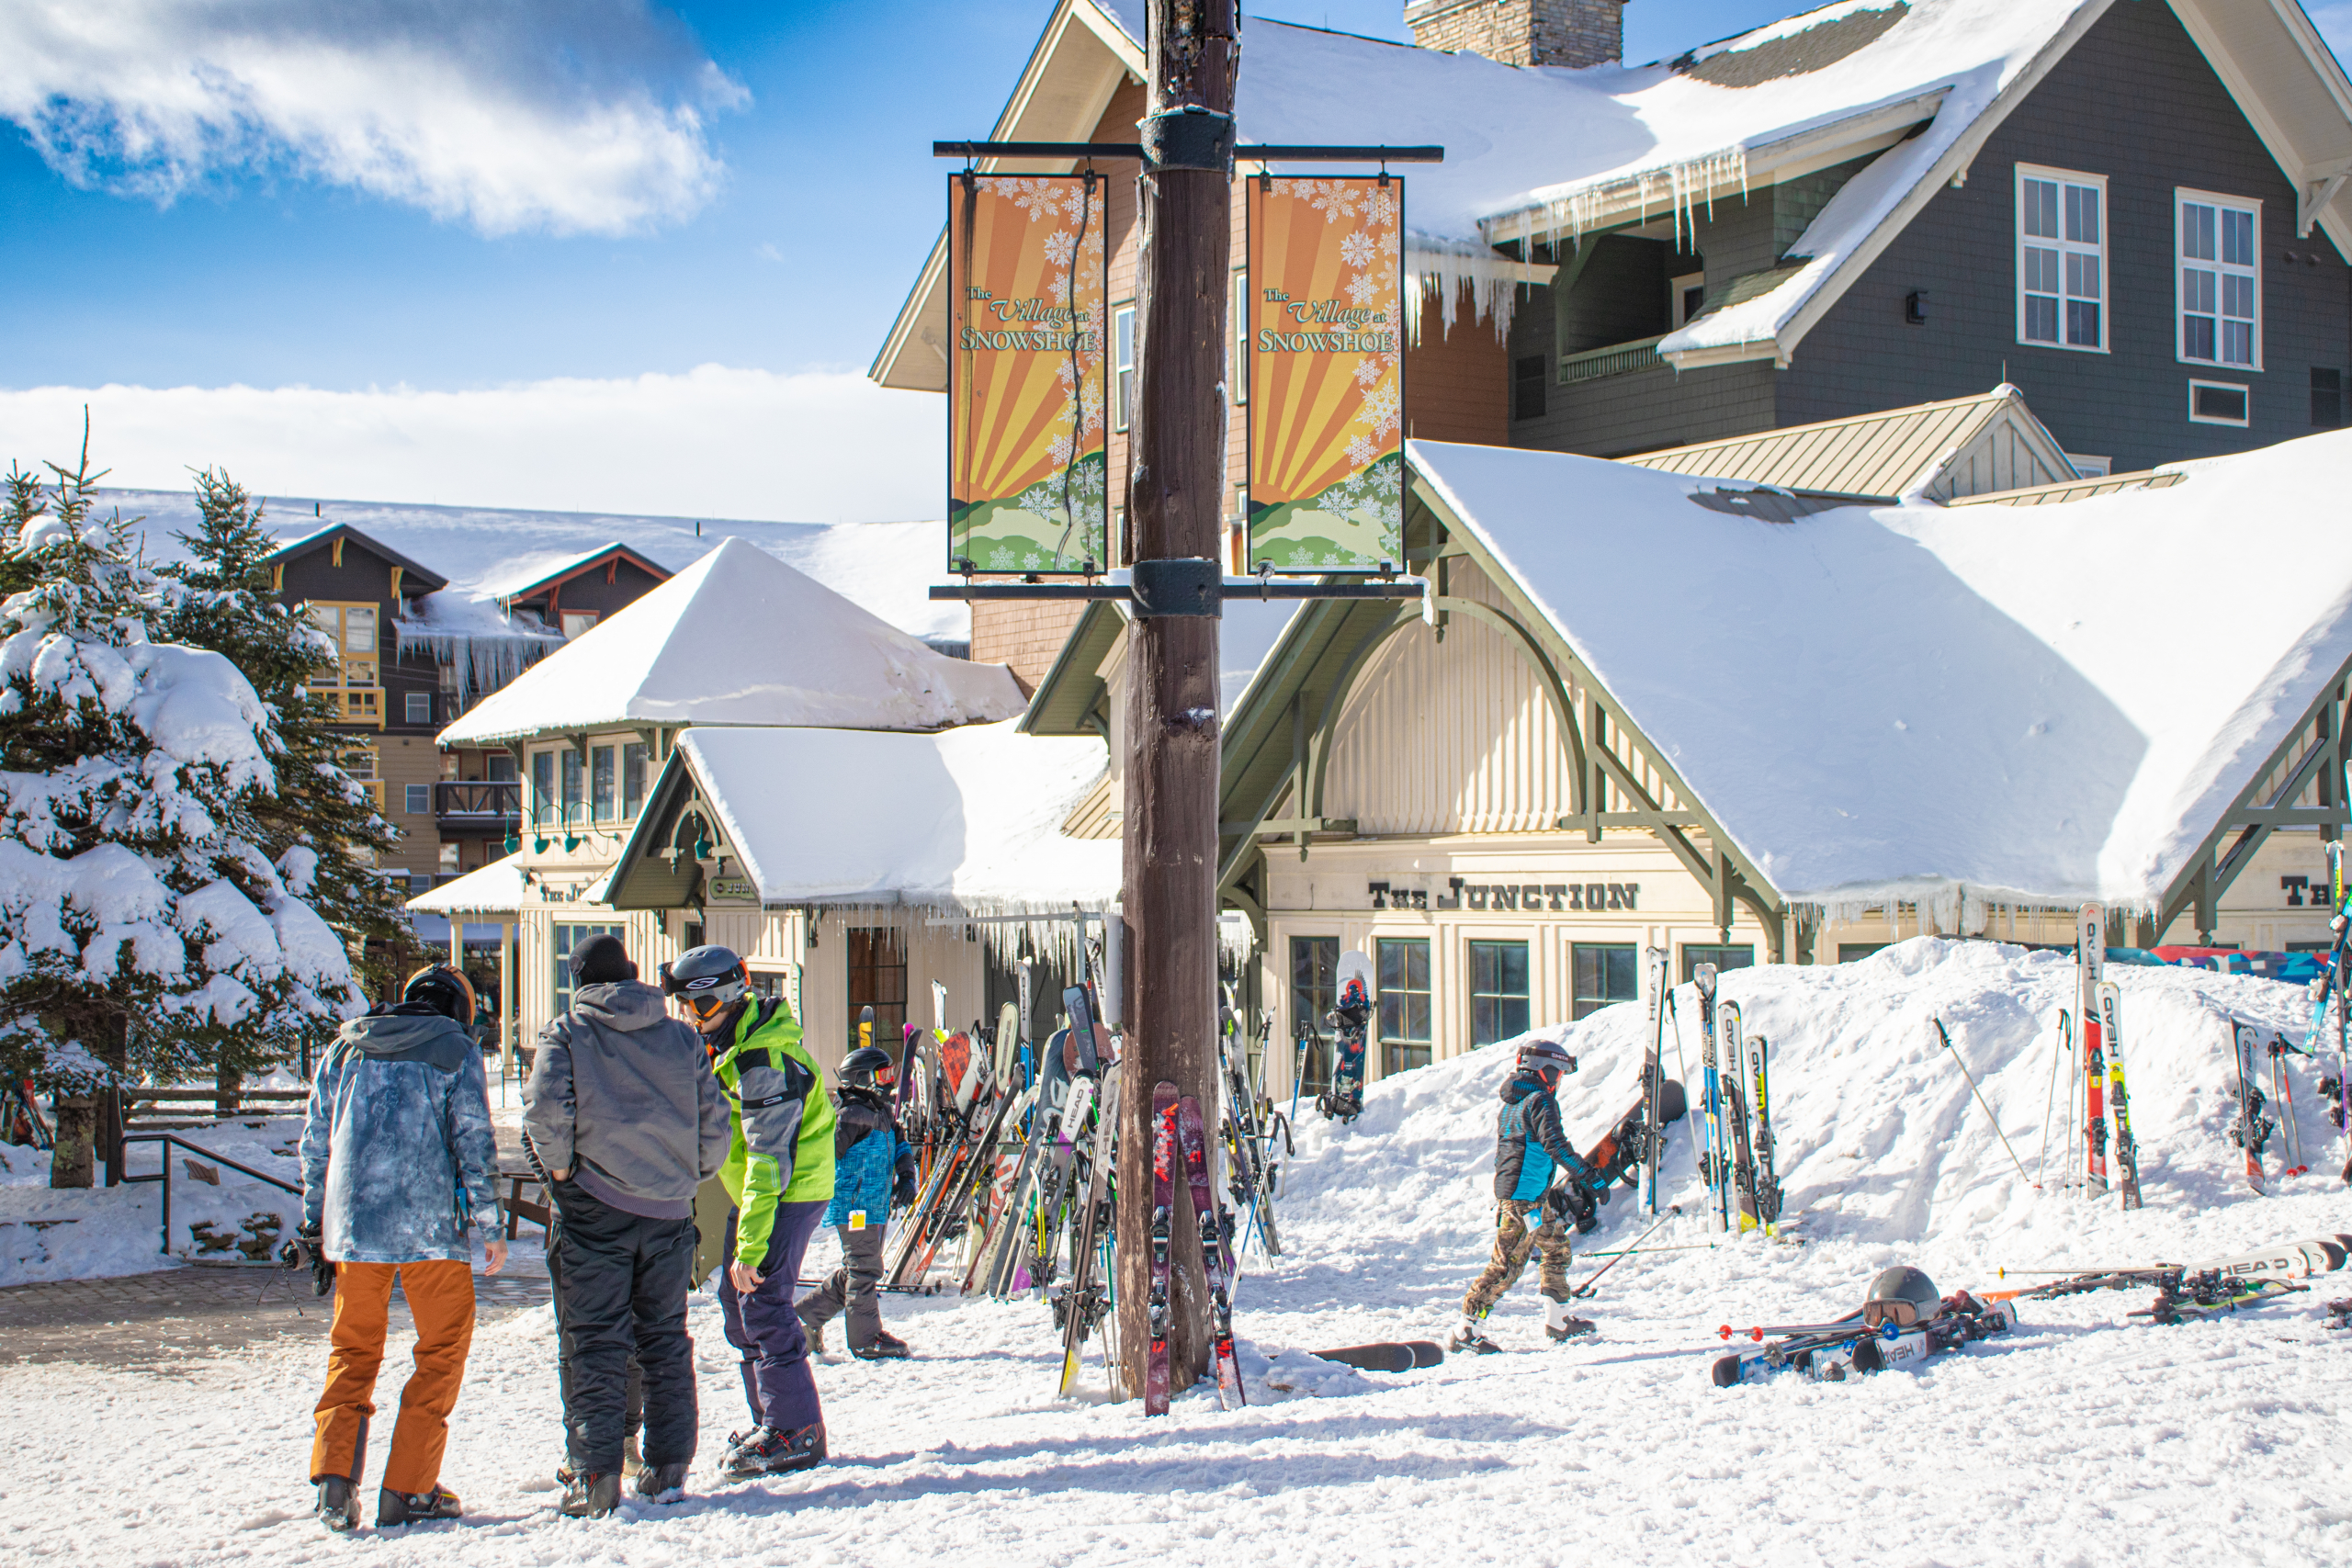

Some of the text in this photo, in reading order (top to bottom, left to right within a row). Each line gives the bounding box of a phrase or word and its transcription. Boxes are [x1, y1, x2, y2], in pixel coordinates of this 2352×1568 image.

[967, 287, 991, 299] The
[1263, 288, 1289, 301] The
[989, 298, 1090, 328] Village at
[1287, 299, 1386, 330] Village at
[960, 326, 1097, 351] SNOWSHOE
[1258, 328, 1394, 352] SNOWSHOE
[1437, 877, 1639, 910] JUNCTION
[2103, 997, 2120, 1057] HEAD
[1551, 1052, 1568, 1061] SMITH
[1725, 1019, 1736, 1072] HEAD
[2243, 1039, 2252, 1073] HEAD
[1752, 1052, 1763, 1107] HEAD
[1068, 1089, 1084, 1128] HEAD
[1455, 1341, 1479, 1351] HEAD
[783, 1452, 810, 1461] HEAD
